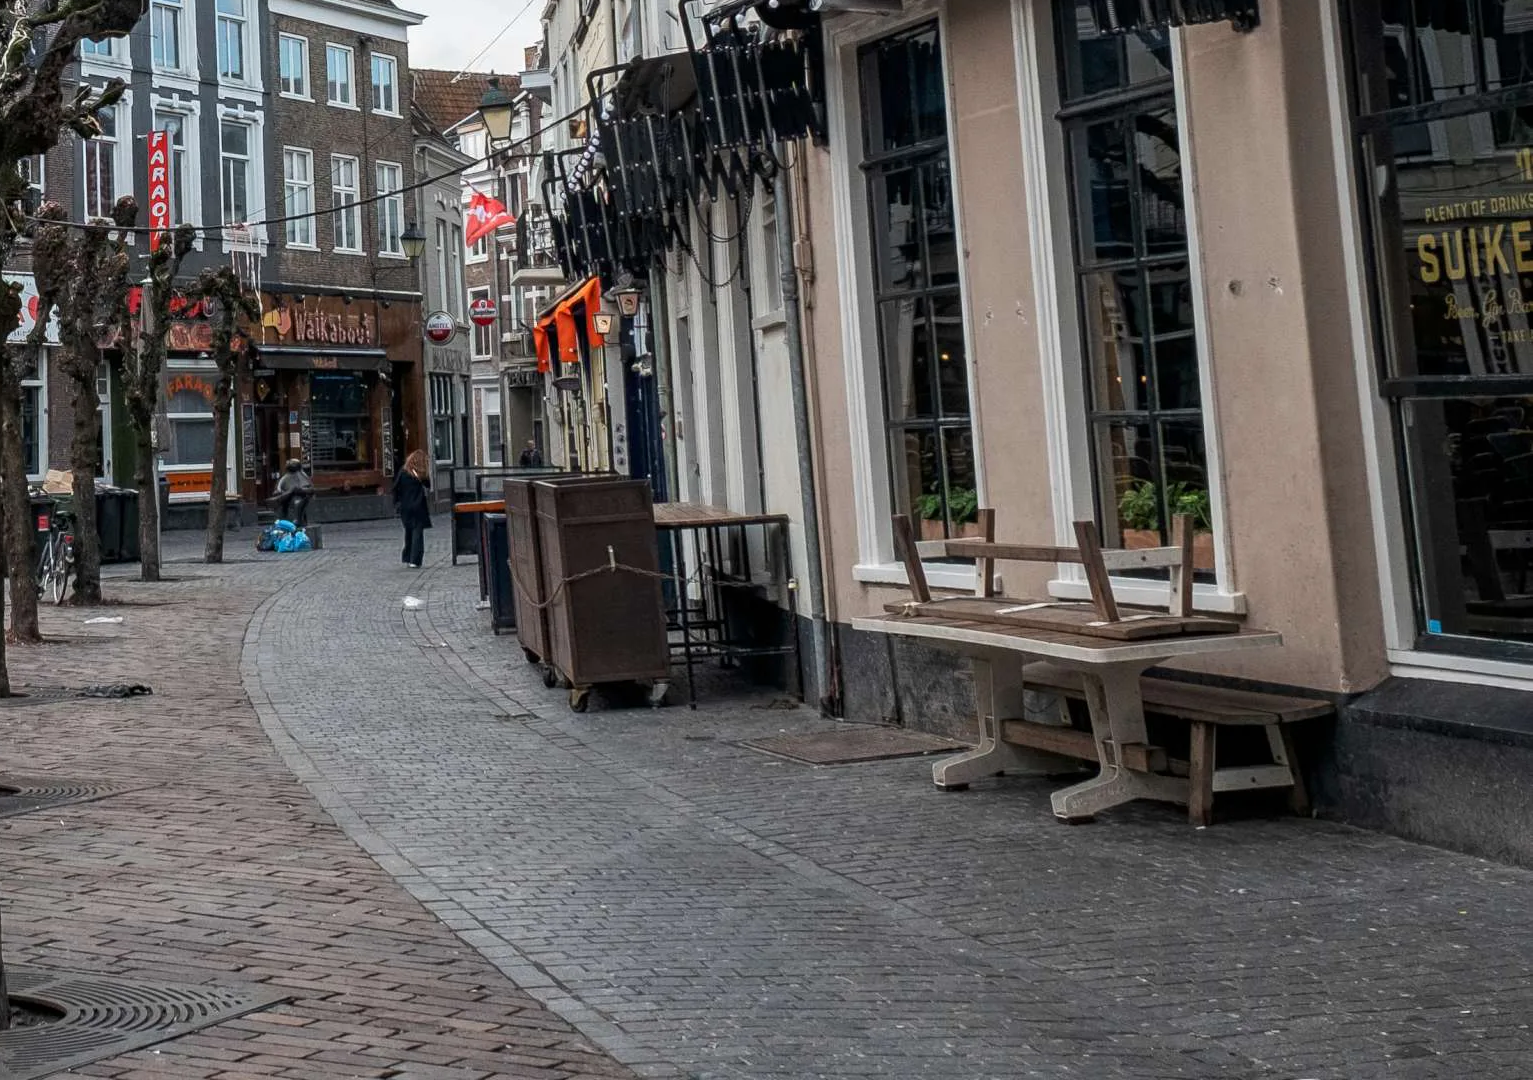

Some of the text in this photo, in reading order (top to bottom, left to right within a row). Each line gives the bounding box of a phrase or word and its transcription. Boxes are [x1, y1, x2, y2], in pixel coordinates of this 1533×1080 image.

[1425, 192, 1533, 223] PLENTY OF DRINKS
